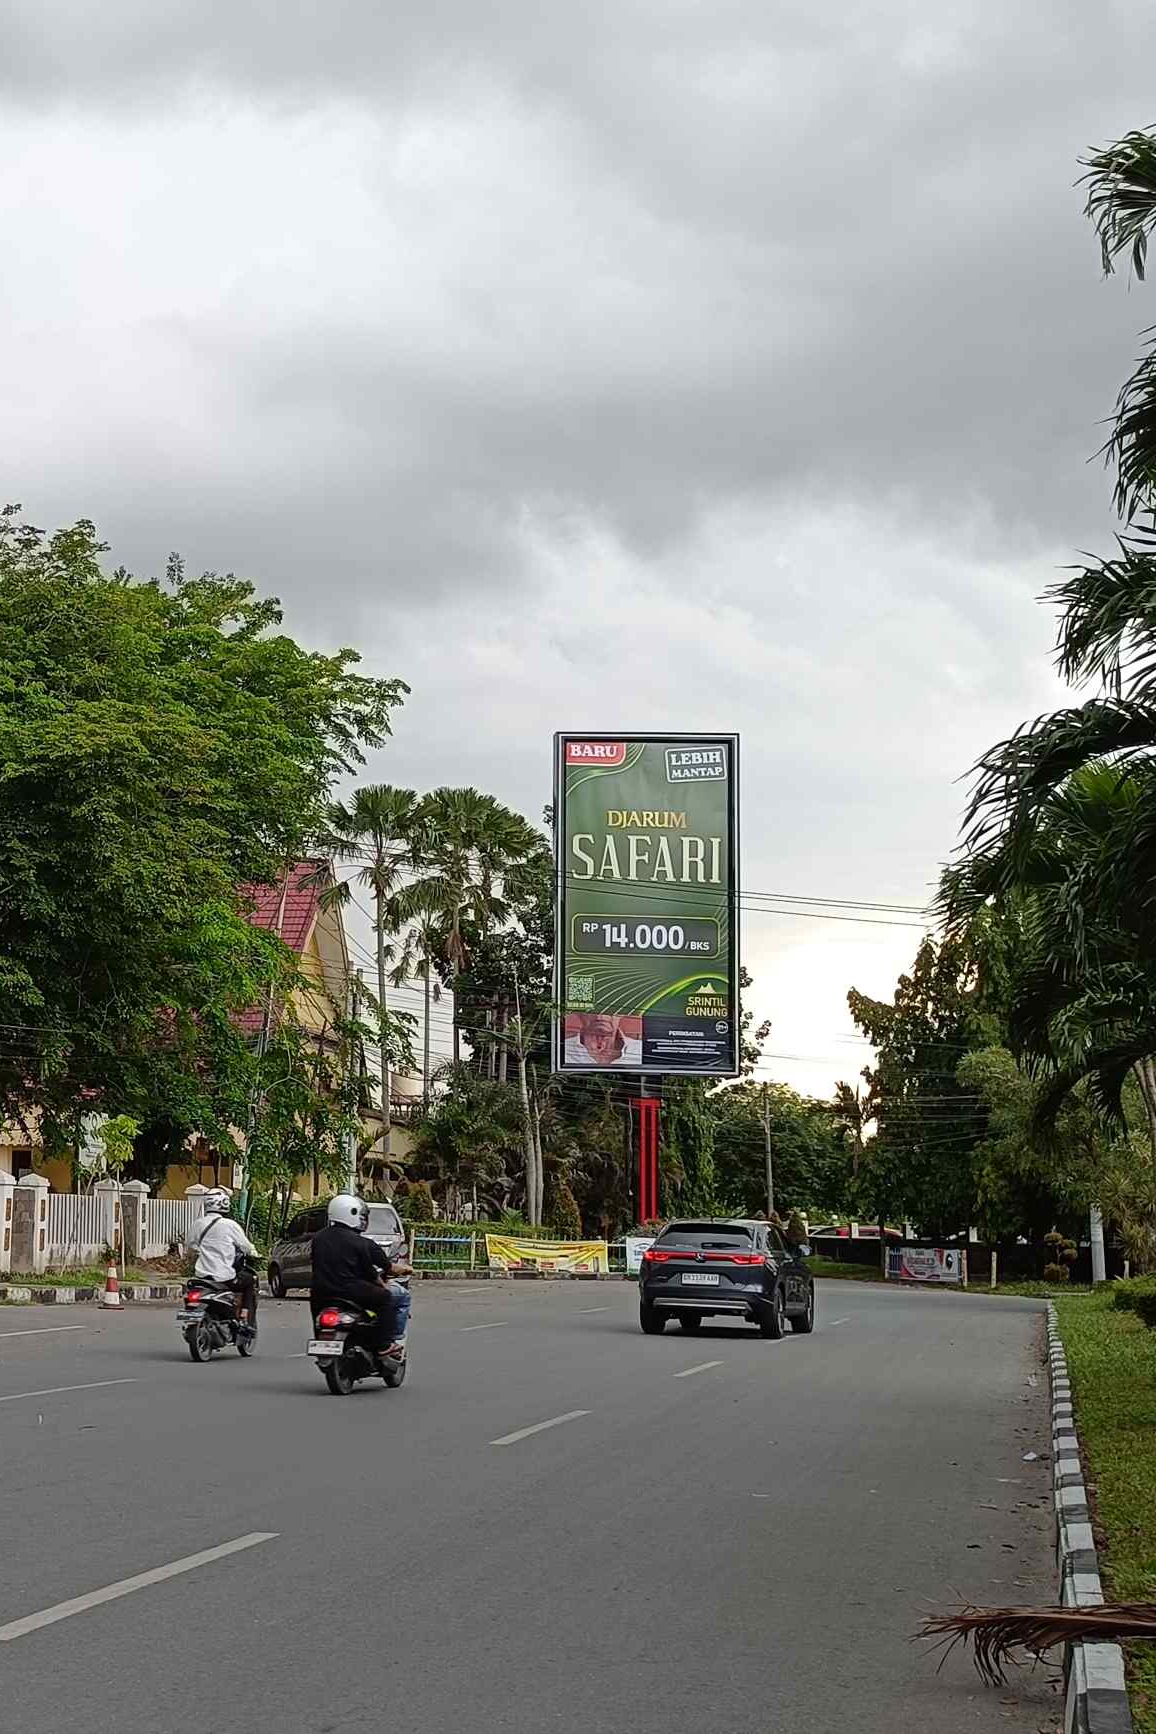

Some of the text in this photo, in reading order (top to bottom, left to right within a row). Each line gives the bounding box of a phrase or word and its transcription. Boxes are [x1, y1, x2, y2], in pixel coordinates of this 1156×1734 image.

[570, 744, 617, 757] BARU
[670, 752, 721, 765] LEBIH
[671, 767, 723, 779] MANTAP
[607, 810, 687, 828] DJARUM
[571, 834, 722, 883] SAFARI
[582, 923, 598, 933] RP
[602, 923, 685, 950] 14.000
[687, 996, 726, 1007] SRINTIL
[685, 1006, 728, 1017] GUNUNG
